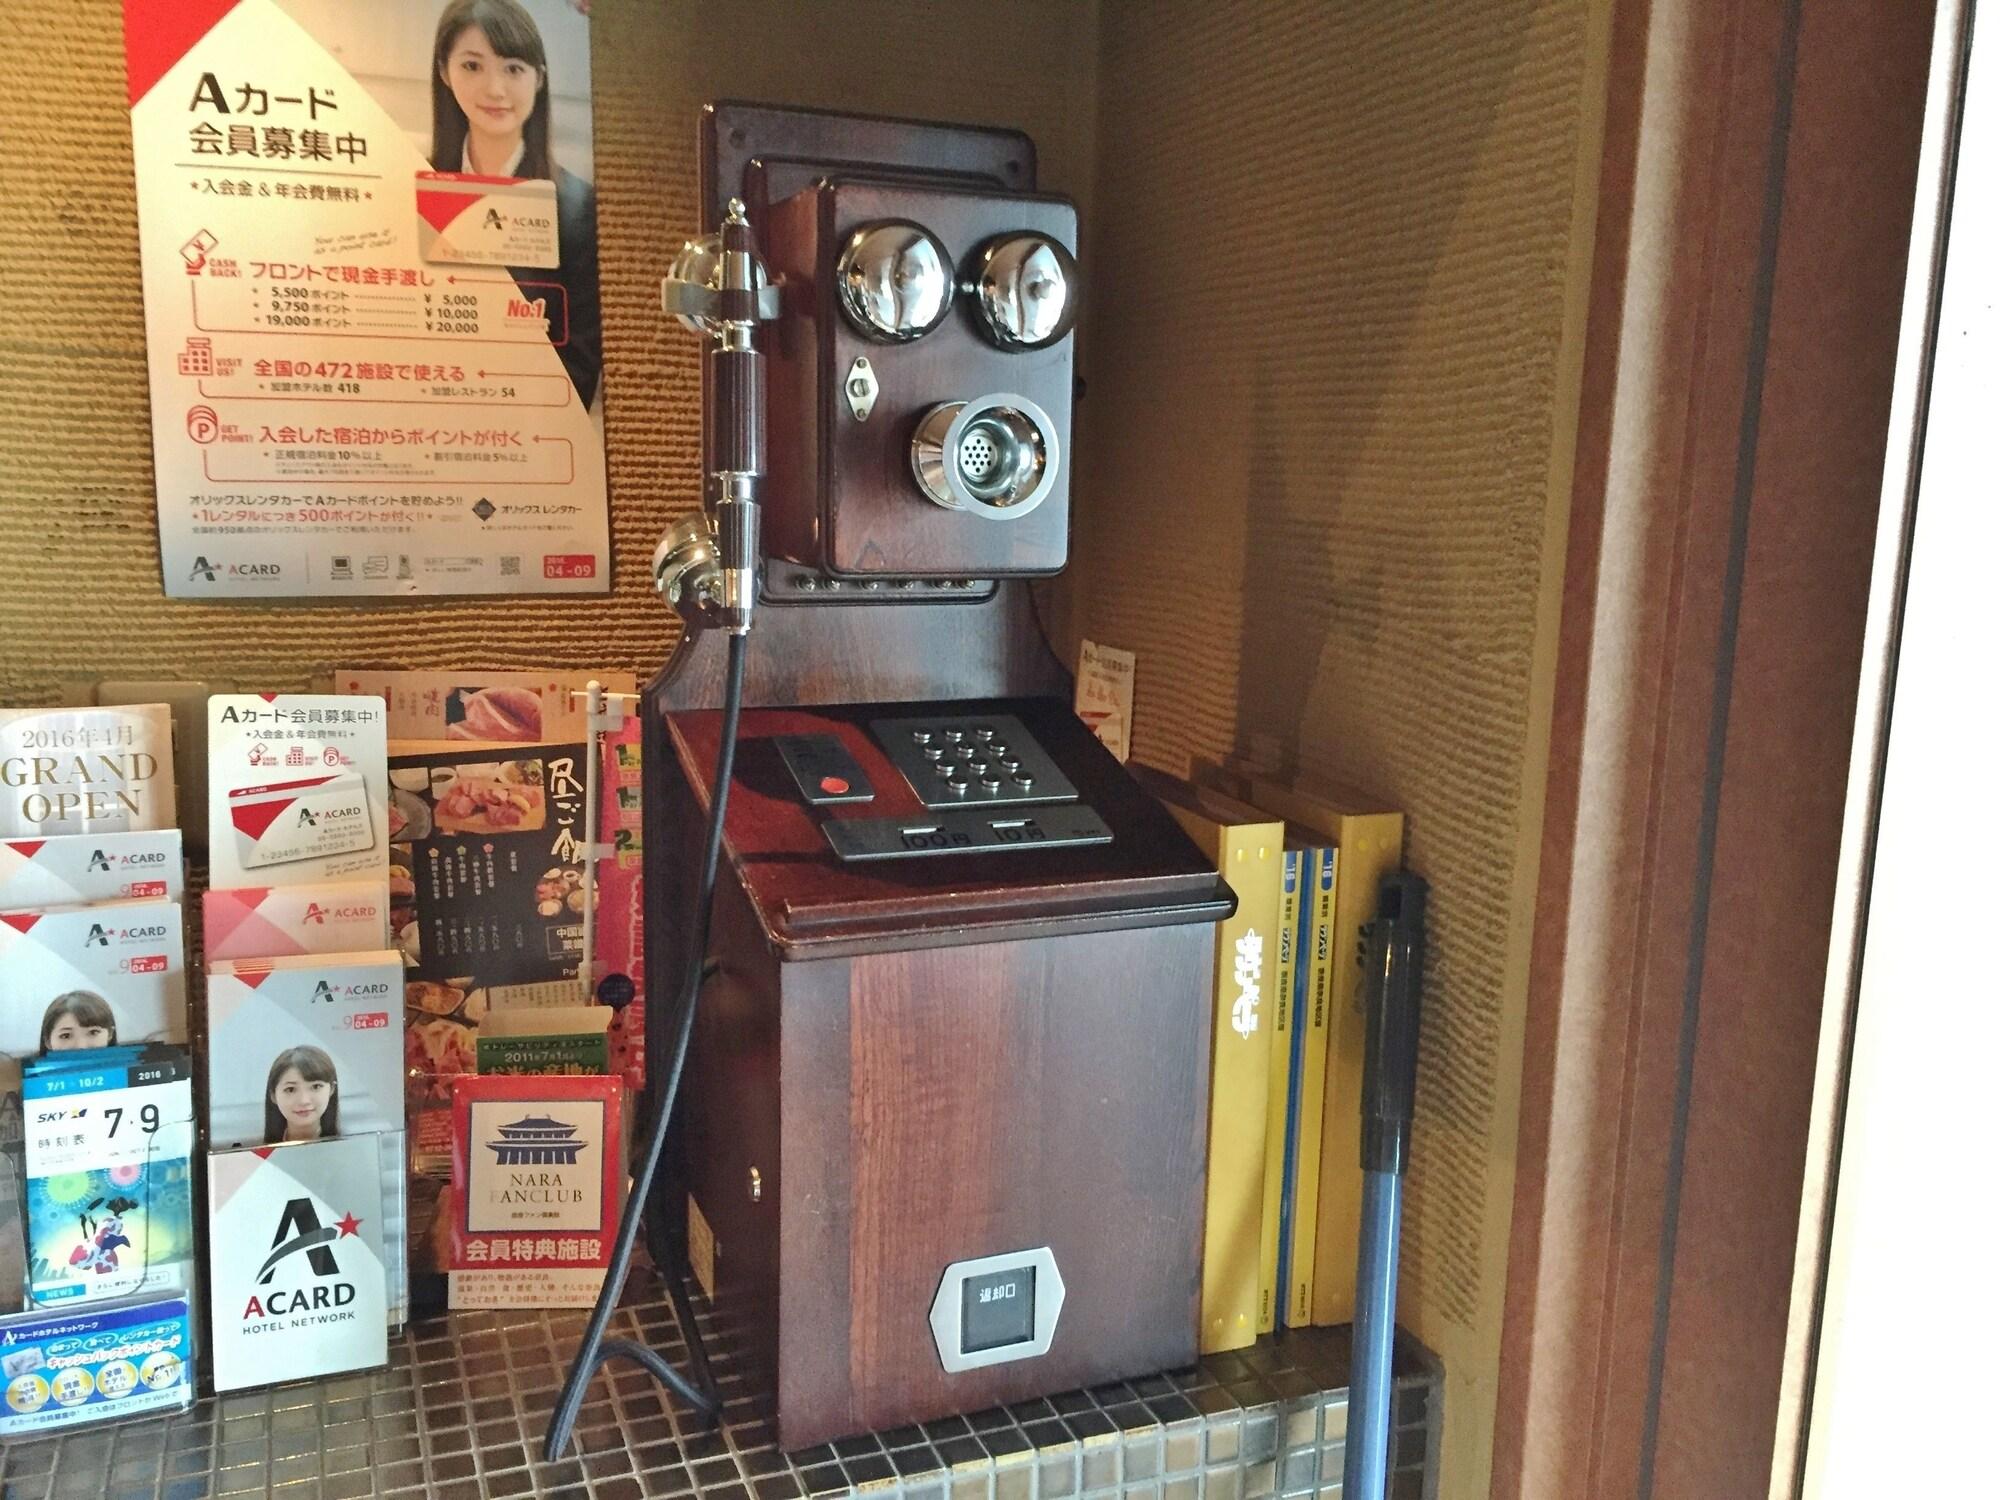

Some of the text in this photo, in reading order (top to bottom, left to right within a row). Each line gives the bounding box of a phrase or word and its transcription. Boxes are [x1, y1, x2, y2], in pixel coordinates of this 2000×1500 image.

[189, 72, 338, 121] Aカード
[189, 122, 368, 165] 会員募集中
[512, 217, 550, 229] ACARD
[209, 258, 238, 268] CASH
[209, 268, 242, 278] BACK!
[249, 261, 435, 287] フロントで現金手渡し
[442, 293, 478, 306] 5,000
[437, 307, 479, 320] 10,000
[436, 321, 480, 334] 20,000
[254, 358, 466, 382] 全国の472施設で使える
[337, 382, 361, 394] 418
[501, 386, 517, 399] 54
[258, 425, 523, 447] 入会した宿泊からポイントが付く
[228, 564, 281, 576] ACARD
[221, 705, 379, 725] Aカード会員募集中!
[21, 725, 134, 749] 2016年4月
[1, 752, 158, 788] GRAND
[22, 788, 142, 824] OPEN
[324, 806, 361, 820] ACARD
[121, 853, 166, 865] ACARD
[334, 906, 377, 918] ACARD
[120, 926, 167, 938] ACARD
[345, 983, 389, 996] ACARD
[78, 1076, 104, 1088] 10/2
[37, 1110, 69, 1123] SKY
[510, 1172, 563, 1188] NARA
[465, 1238, 602, 1262] 会員特典施設
[979, 1283, 1017, 1304] 返却口
[243, 1282, 356, 1320] ACARD
[243, 1310, 356, 1336] HOTEL NETWORK
